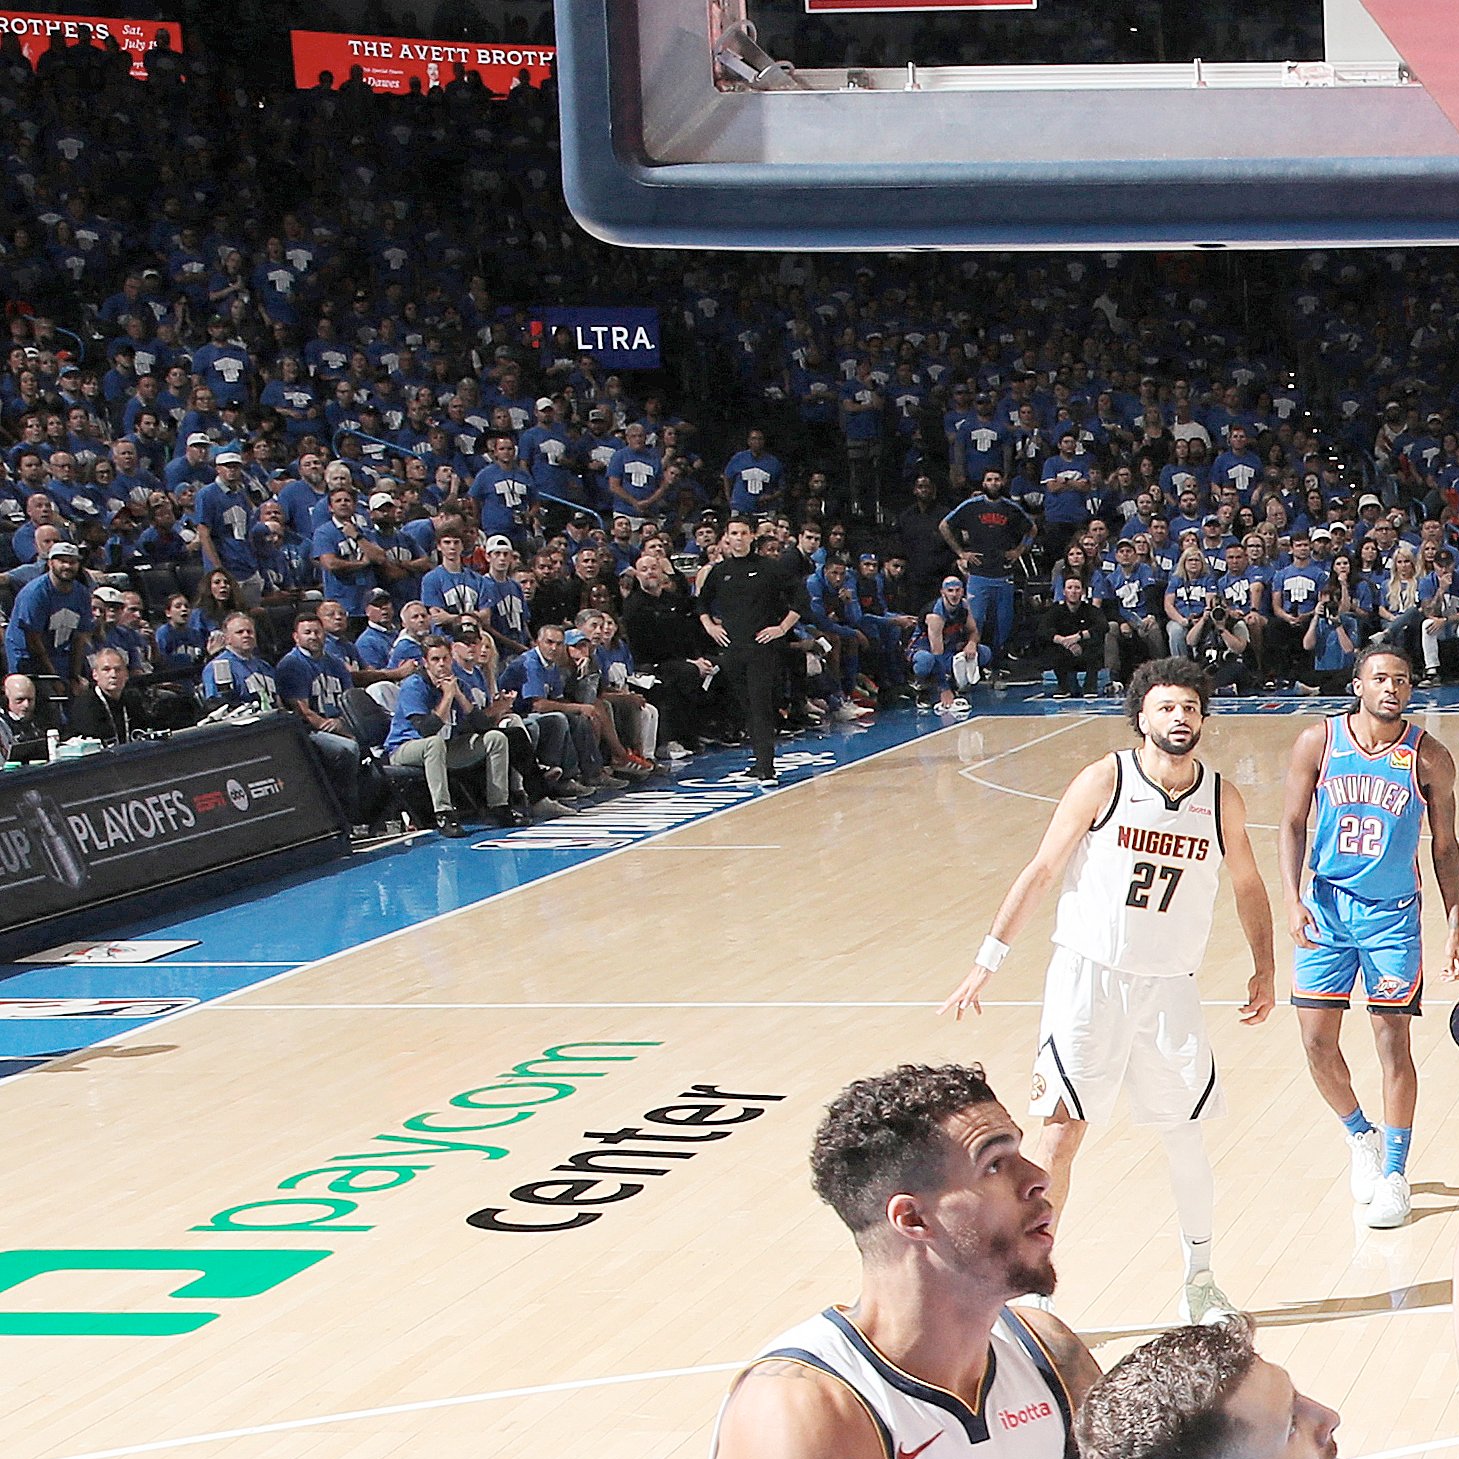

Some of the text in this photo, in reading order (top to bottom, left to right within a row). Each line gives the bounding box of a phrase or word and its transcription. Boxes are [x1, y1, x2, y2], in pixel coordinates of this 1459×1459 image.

[121, 38, 145, 51] July
[122, 24, 143, 36] Sat,
[348, 40, 393, 58] THE
[399, 44, 470, 63] AVETT
[367, 77, 400, 89] Dawes
[1323, 775, 1411, 817] THUNDER
[67, 789, 196, 854] PLAYOFFS
[1338, 815, 1384, 857] 22
[1117, 825, 1210, 861] NUGGETS
[1125, 861, 1185, 913] 27
[185, 1041, 665, 1233] paycom
[466, 1084, 788, 1233] center
[998, 1402, 1053, 1430] ibotta
